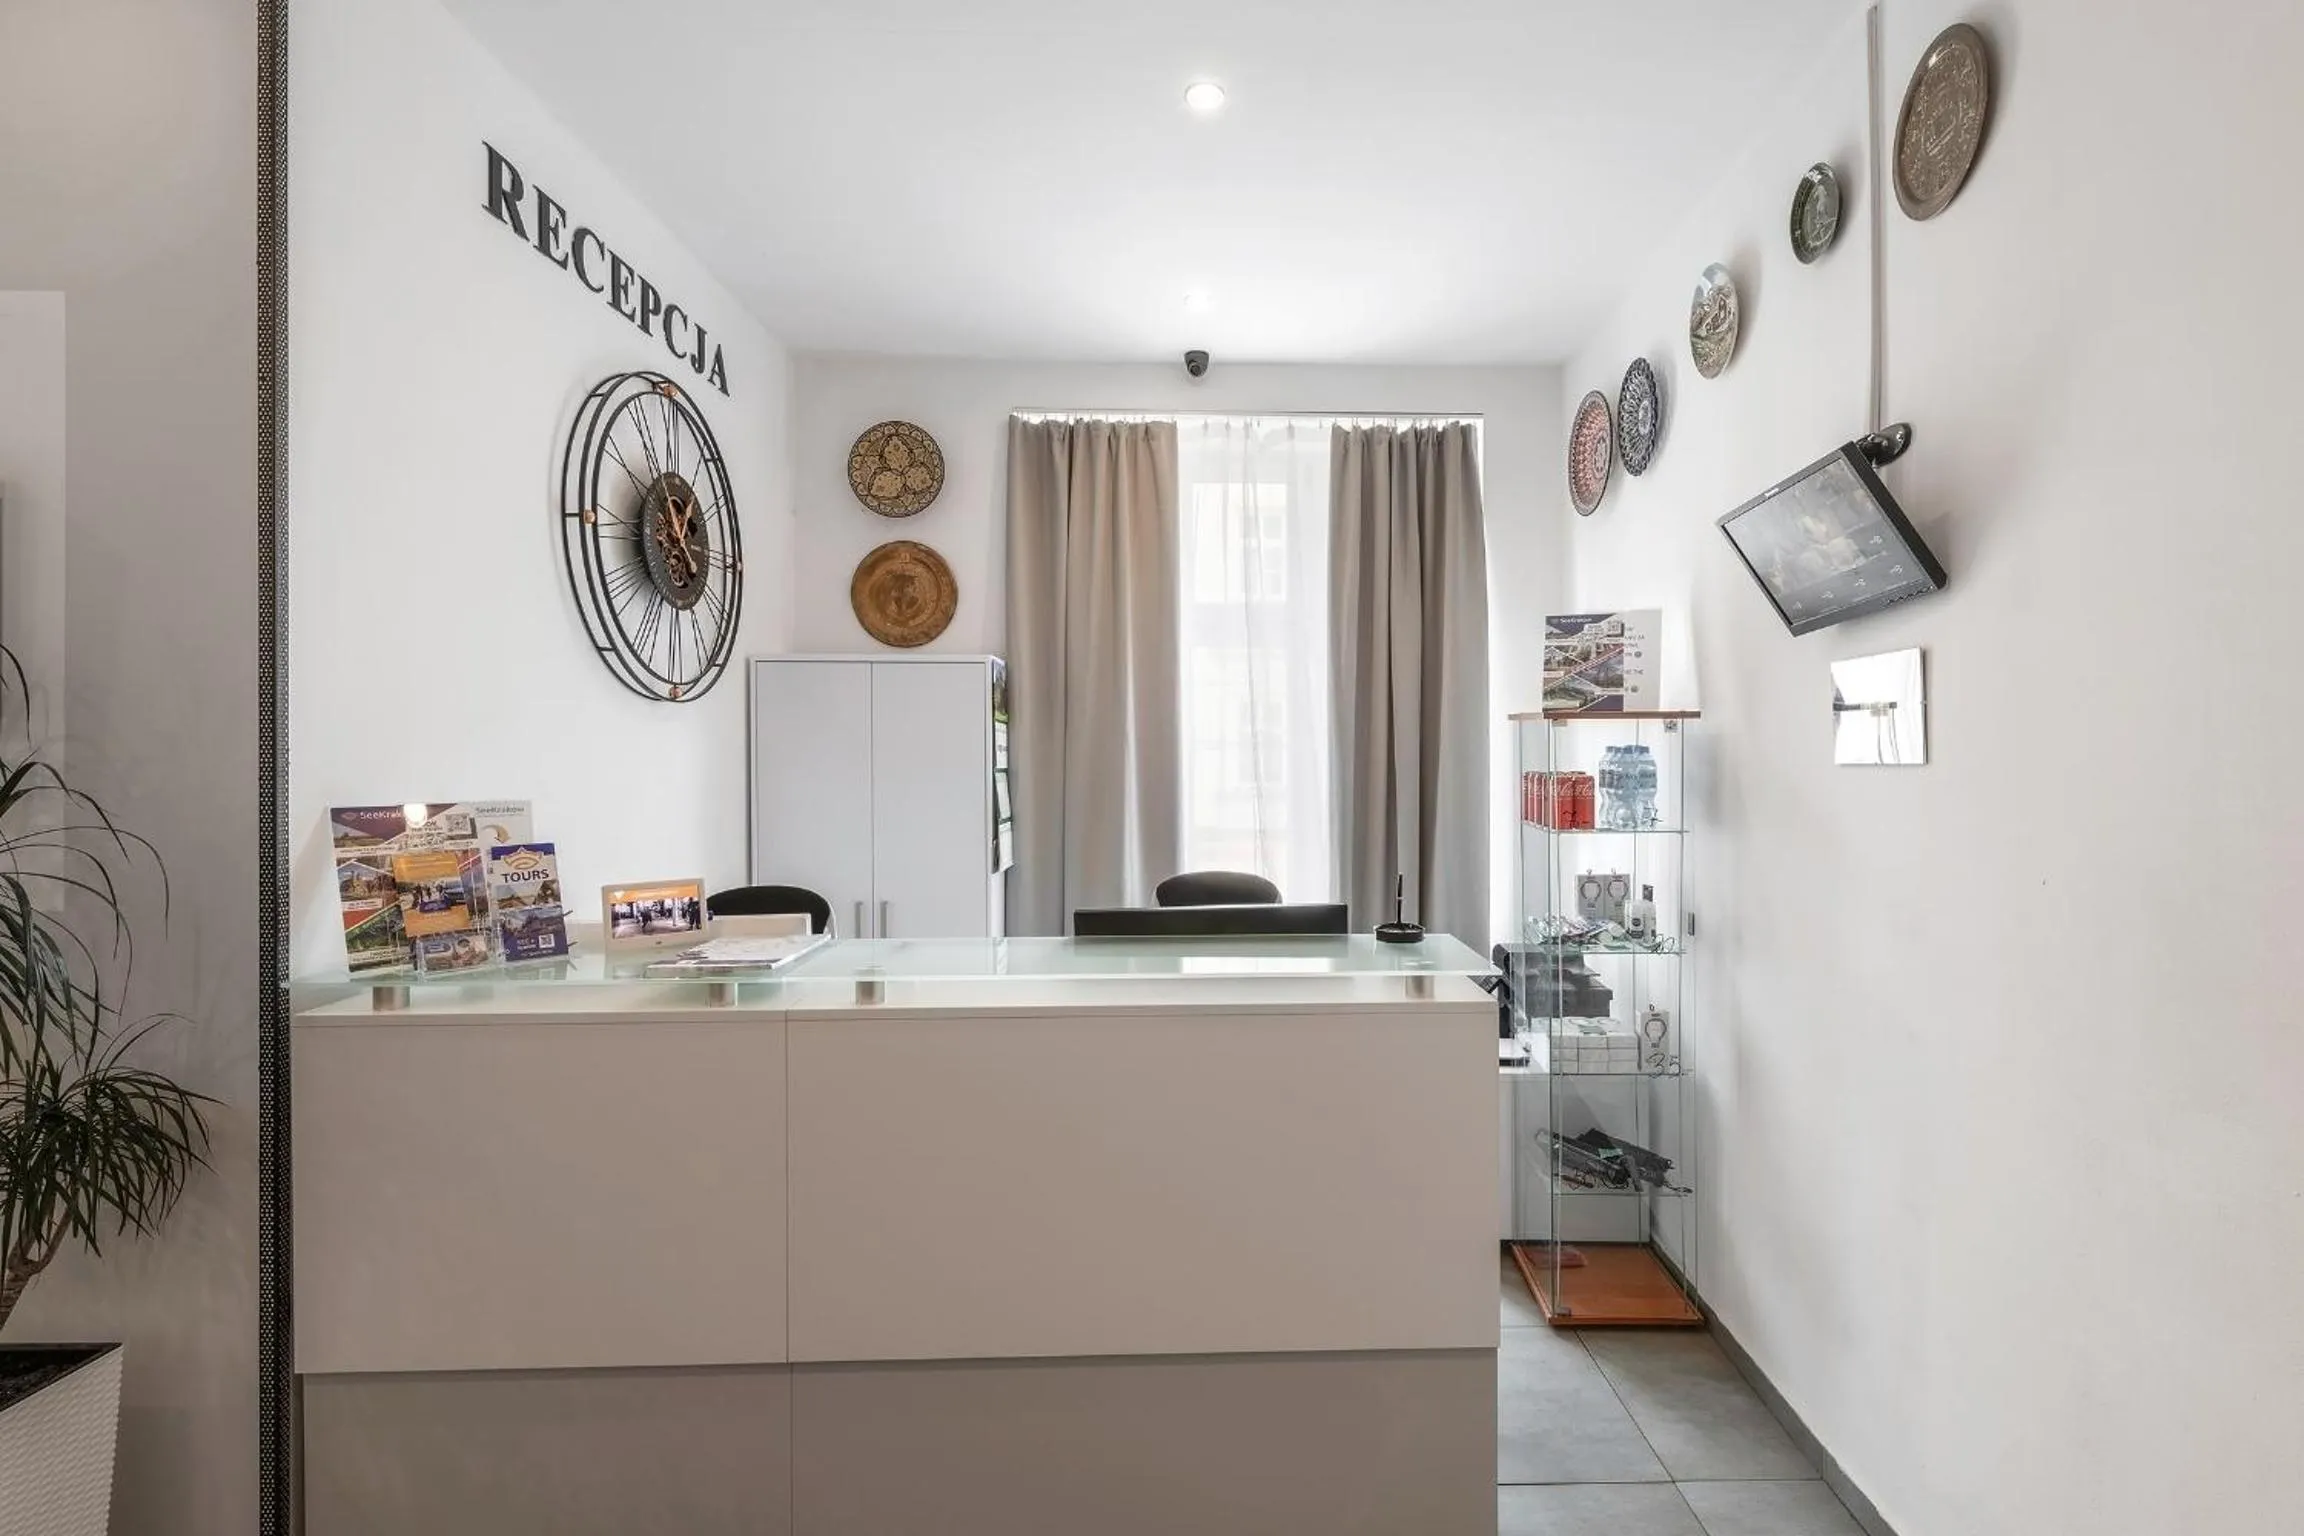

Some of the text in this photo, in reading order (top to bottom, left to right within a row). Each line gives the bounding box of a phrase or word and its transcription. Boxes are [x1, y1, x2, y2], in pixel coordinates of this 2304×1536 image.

[481, 140, 730, 397] RECEPCJA
[359, 809, 406, 820] SeeKrak
[500, 868, 550, 884] TOURS
